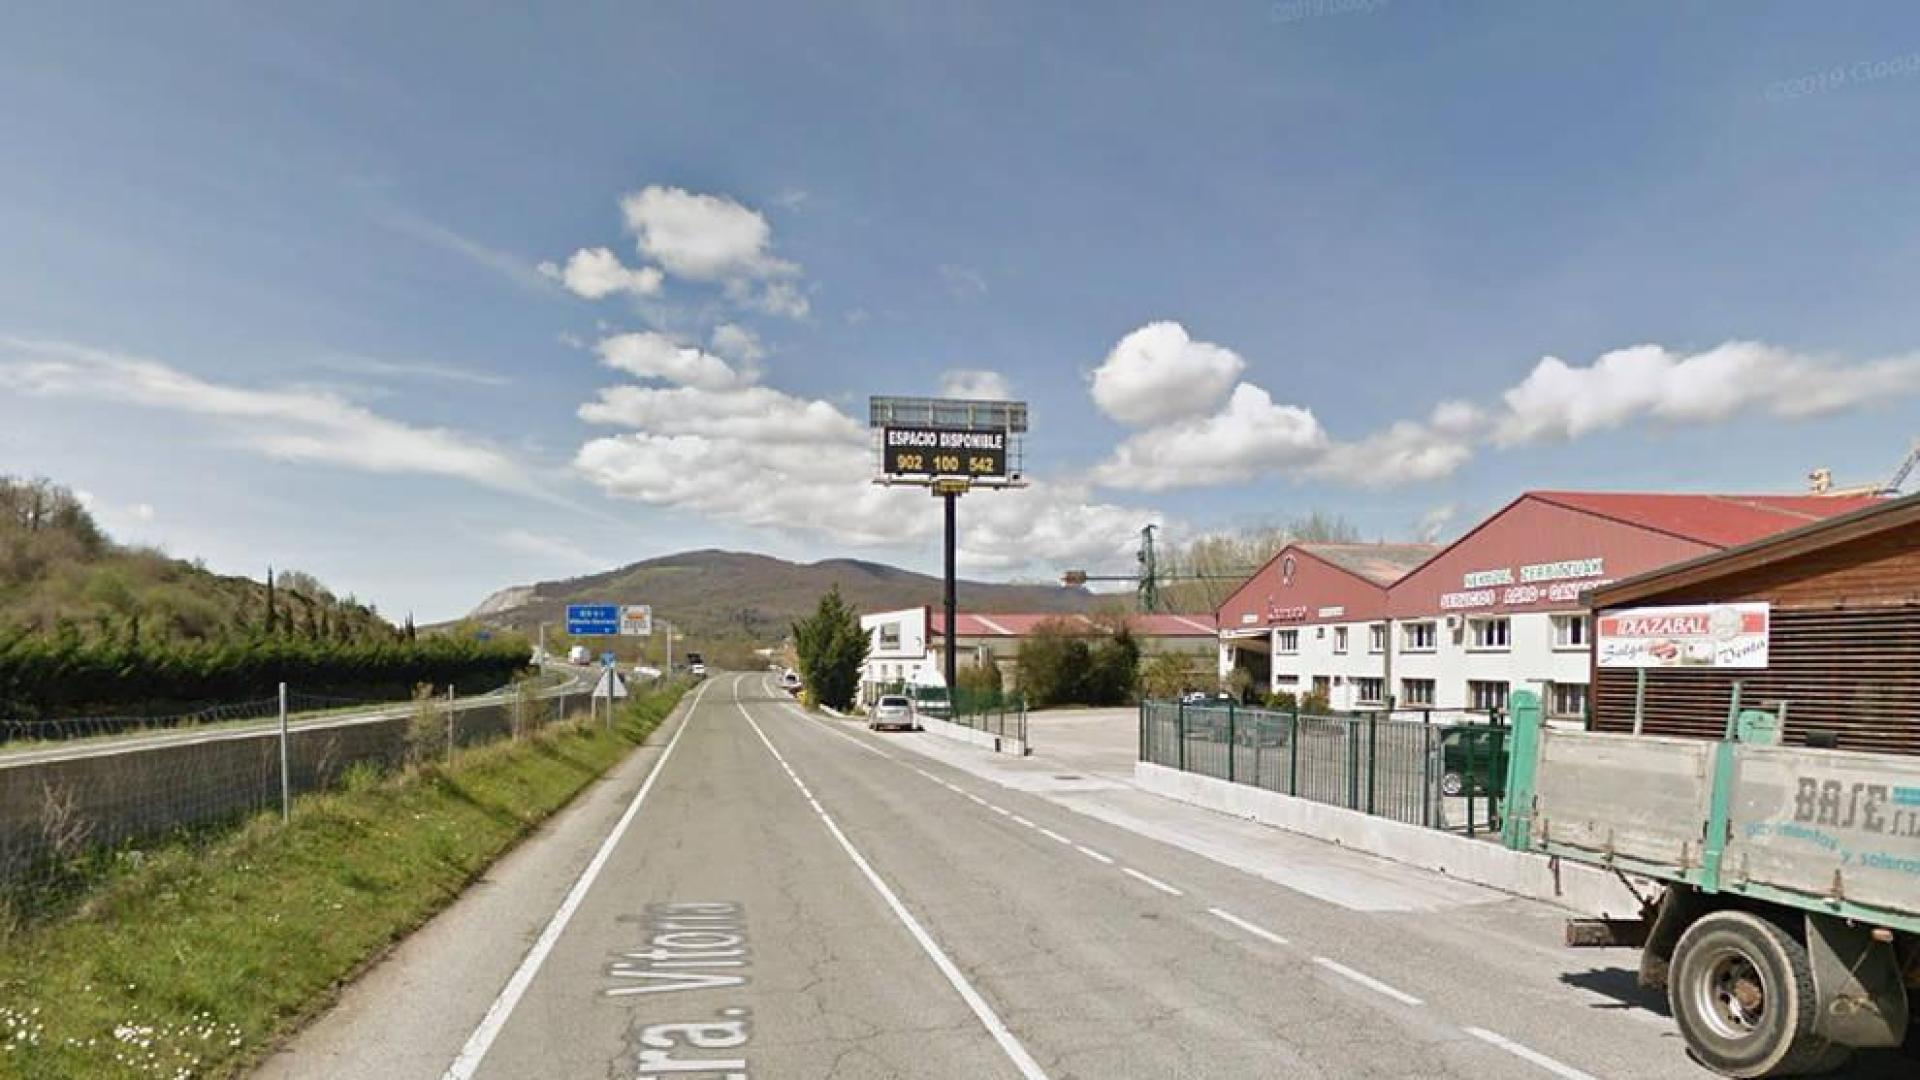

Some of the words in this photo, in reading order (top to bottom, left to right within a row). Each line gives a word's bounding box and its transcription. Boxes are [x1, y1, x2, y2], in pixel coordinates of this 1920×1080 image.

[889, 431, 937, 446] ESPACIO
[941, 433, 1003, 448] DISPONIBLE
[896, 454, 923, 470] 902
[932, 455, 959, 471] 100
[969, 457, 994, 472] 542
